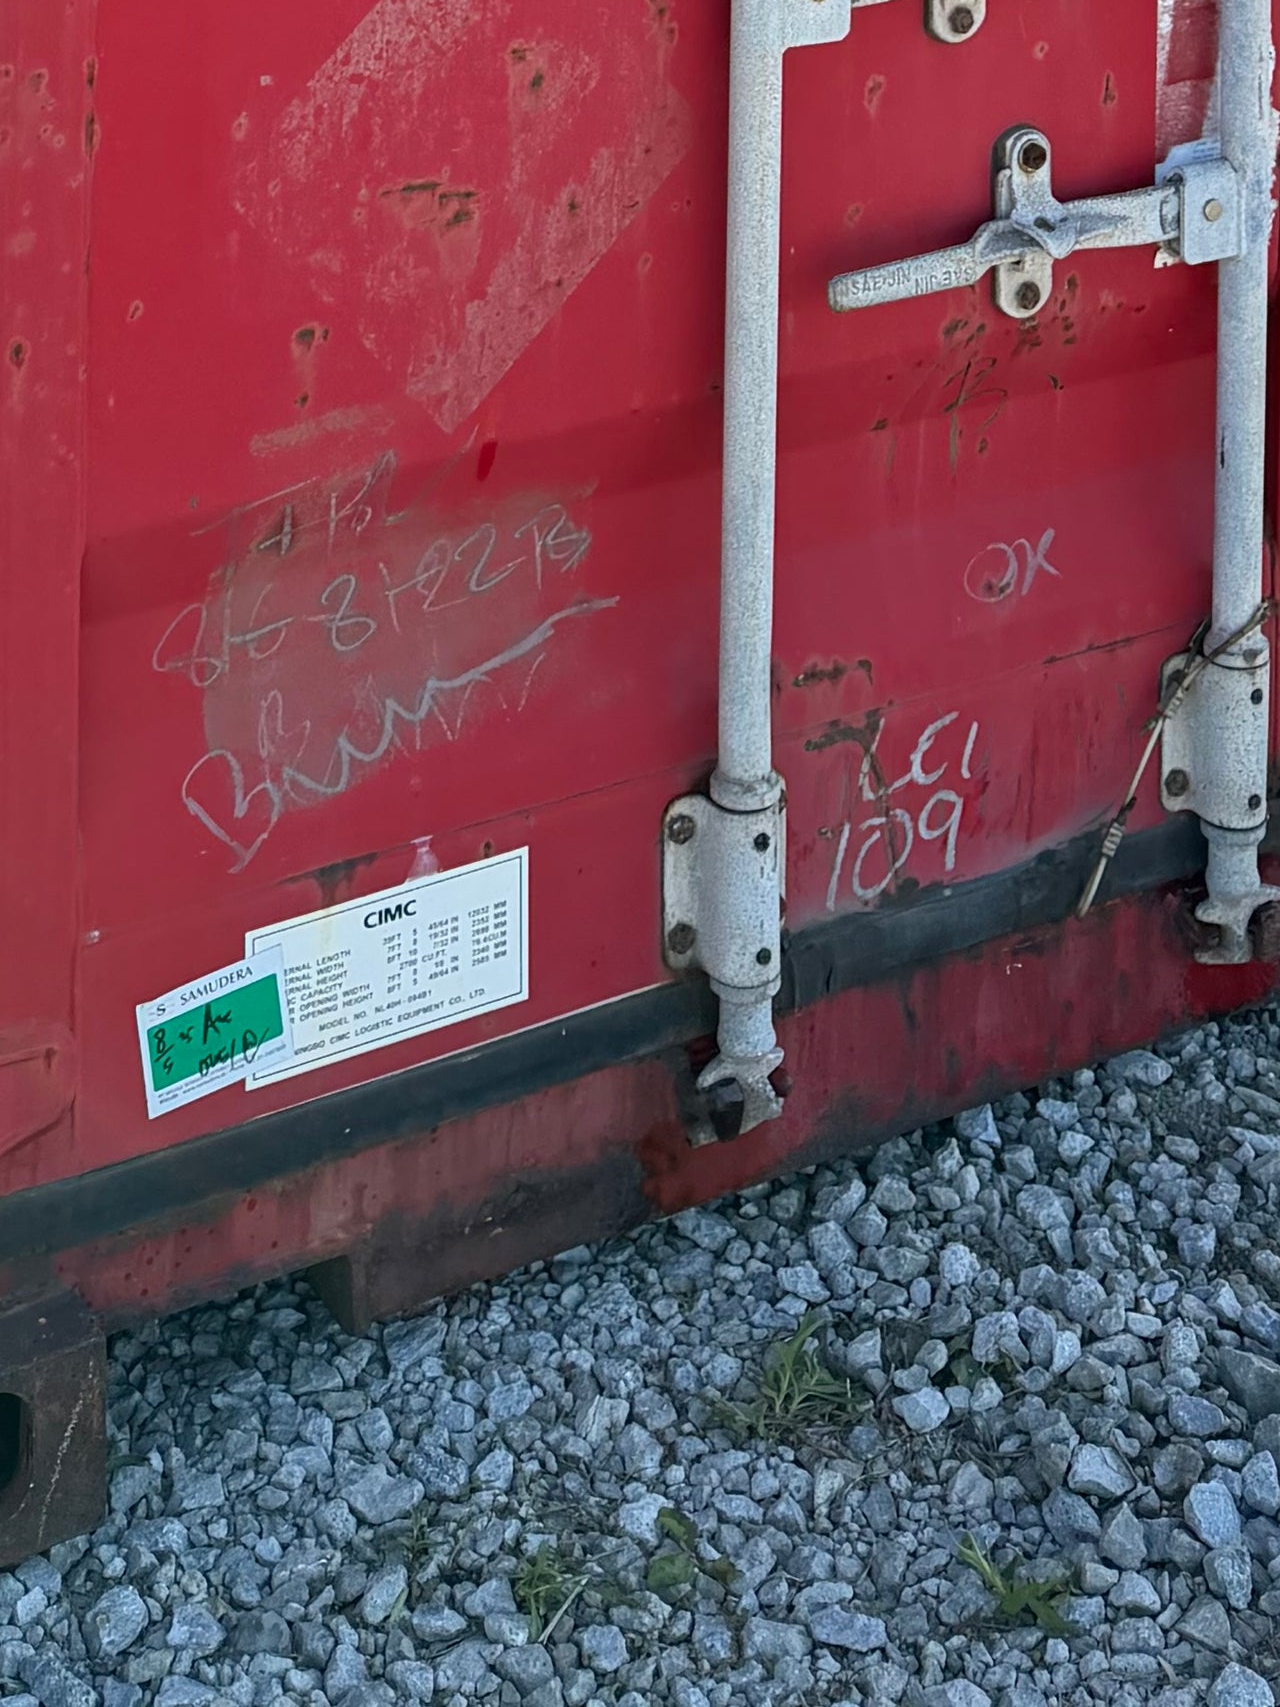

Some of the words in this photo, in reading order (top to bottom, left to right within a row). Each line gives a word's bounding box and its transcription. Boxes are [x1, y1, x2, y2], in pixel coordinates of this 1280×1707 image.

[851, 274, 886, 296] SAE
[316, 949, 351, 965] LENGTH
[450, 915, 459, 924] IN
[493, 900, 507, 910] MM
[363, 899, 417, 929] CIMC
[316, 961, 344, 975] WIDTH
[450, 924, 459, 933] IN
[493, 909, 507, 920] MM
[316, 970, 348, 985] HEIGHT
[450, 934, 459, 943] IN
[493, 919, 507, 930] MM
[180, 965, 253, 1006] SAMUDERA
[299, 994, 338, 1010] OPENING
[342, 983, 370, 997] WIDTH
[450, 954, 459, 963] IN
[493, 939, 507, 950] MM
[299, 1004, 338, 1021] OPENING
[342, 993, 373, 1007] HEIGHT
[450, 964, 459, 973] IN
[493, 949, 507, 960] MM
[300, 982, 343, 1000] CAPACITY
[318, 1016, 349, 1031] MODEL
[329, 1032, 350, 1044] CIMC
[354, 1018, 393, 1036] LOGISTIC
[397, 1002, 444, 1022] EQUIPMENT
